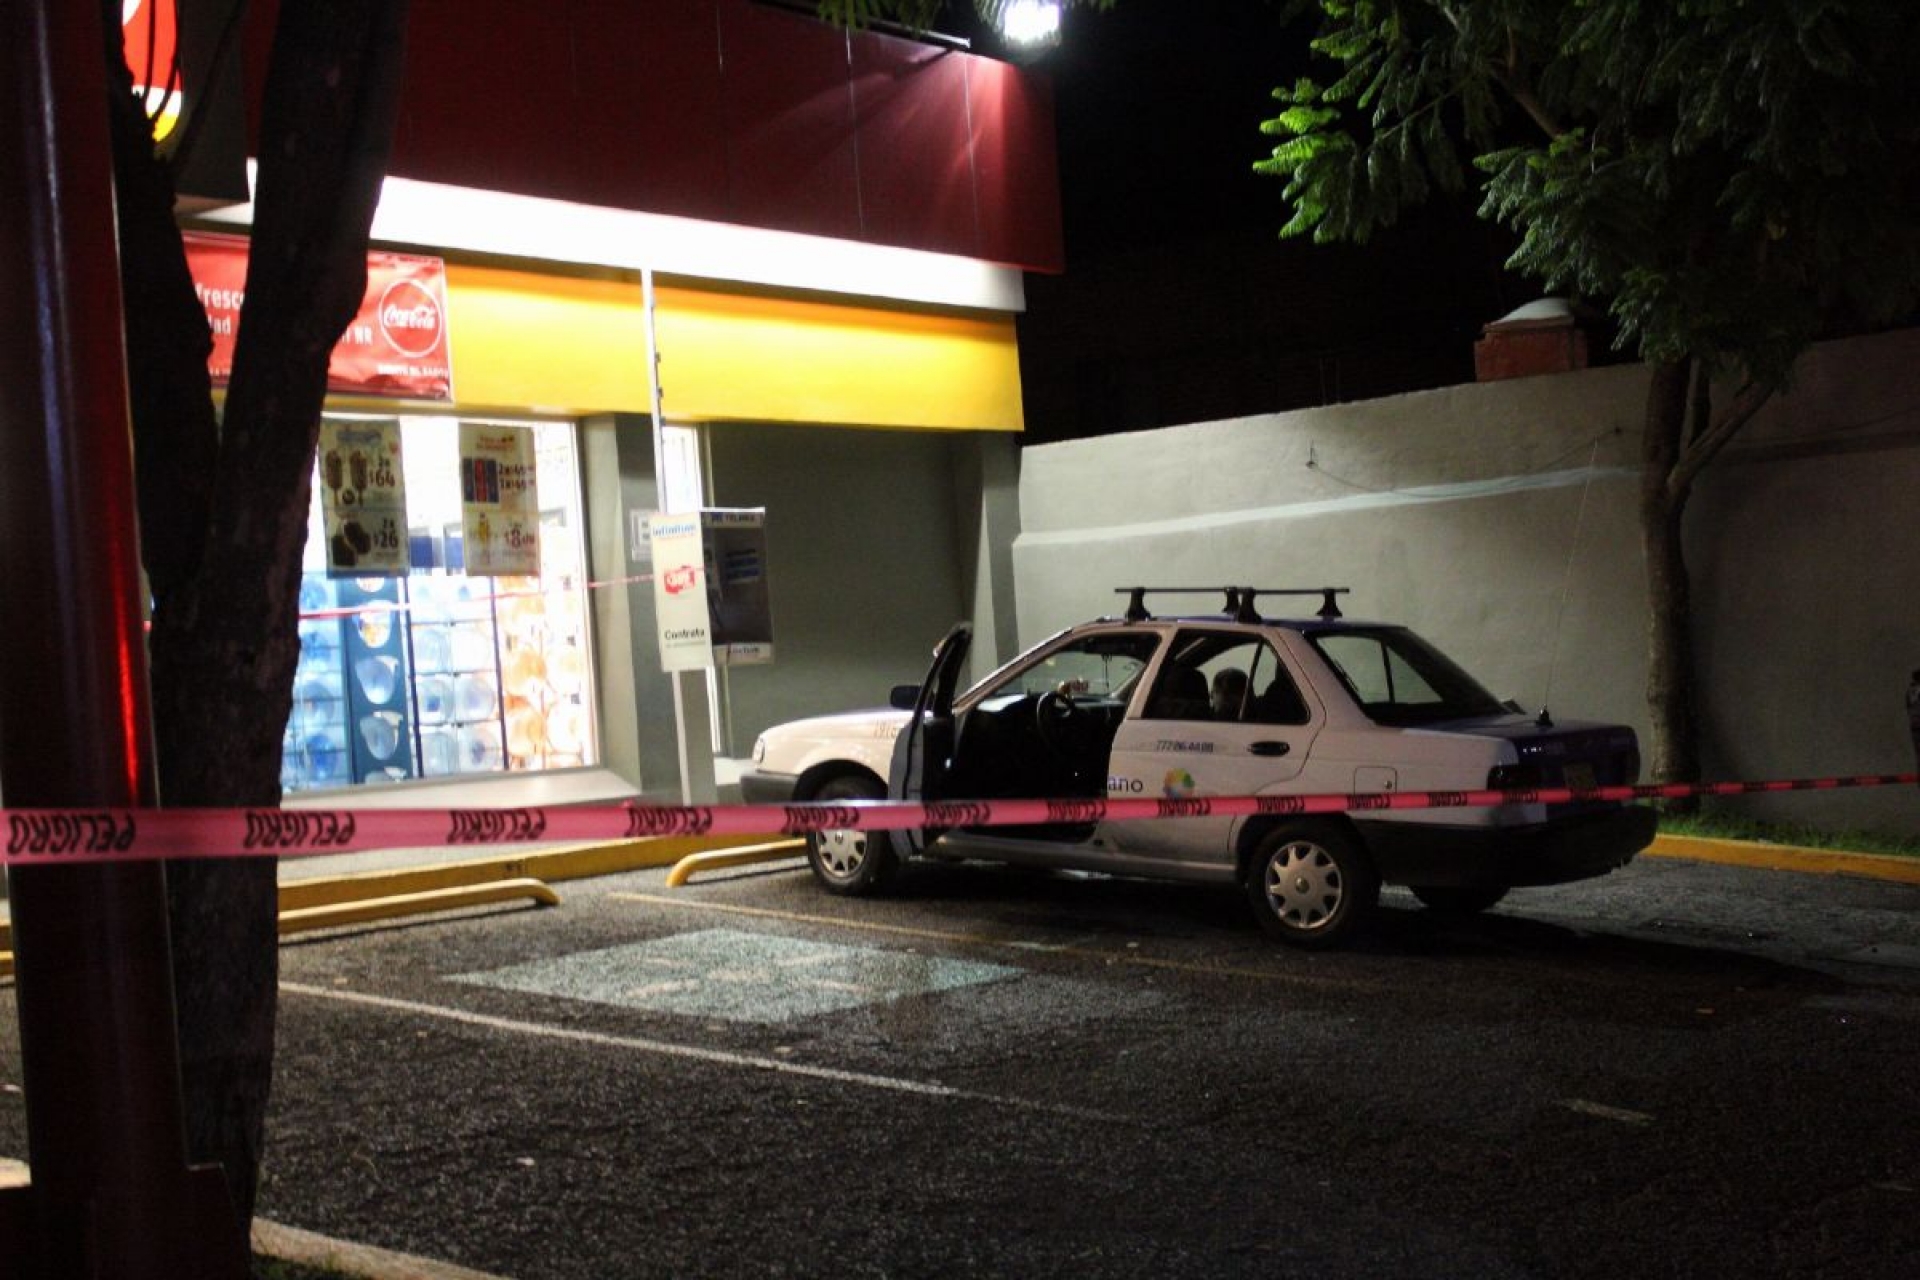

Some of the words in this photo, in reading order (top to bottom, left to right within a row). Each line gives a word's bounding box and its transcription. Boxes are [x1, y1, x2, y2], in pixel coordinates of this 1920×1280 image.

[6, 812, 137, 855] PELIGRO
[242, 810, 356, 848] PELIGRO
[446, 807, 546, 844] PELIGRO
